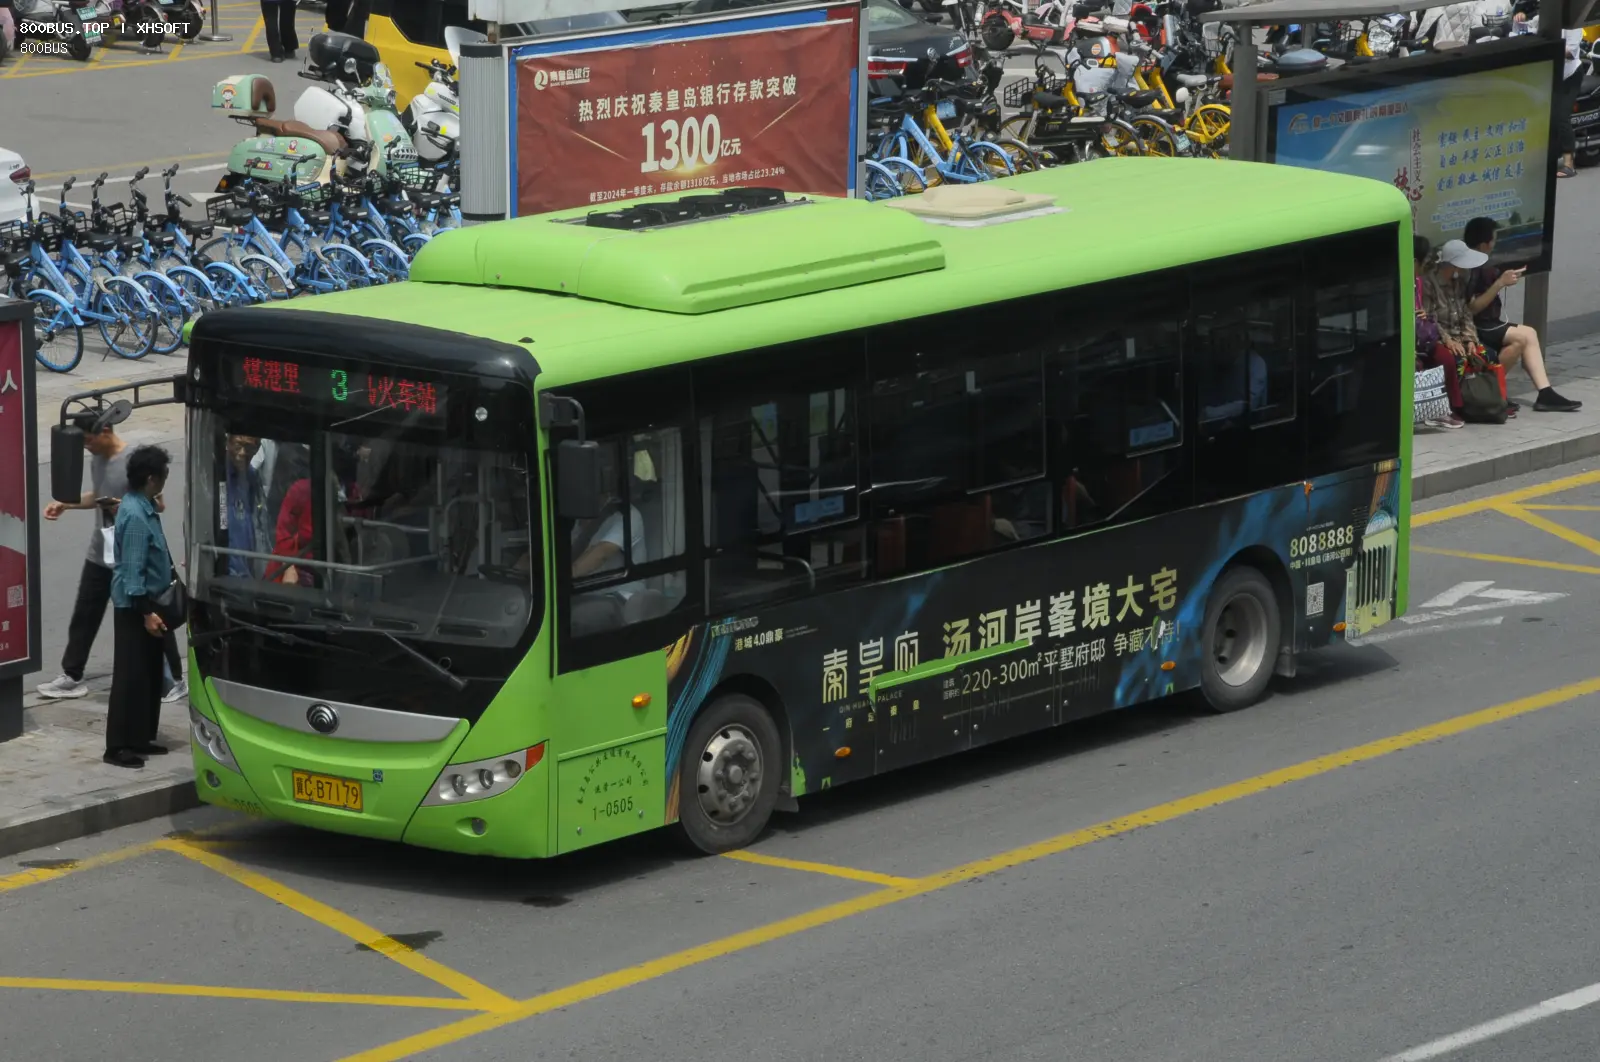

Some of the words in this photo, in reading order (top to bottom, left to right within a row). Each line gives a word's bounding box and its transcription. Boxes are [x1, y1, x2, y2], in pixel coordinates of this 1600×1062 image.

[578, 75, 797, 123] 热烈庆祝秦皇岛银行存款突破
[640, 114, 742, 173] 1300亿元
[331, 369, 348, 401] 3
[1290, 525, 1354, 558] 8088888
[822, 630, 919, 704] 秦皇府
[593, 796, 634, 821] 1-0505
